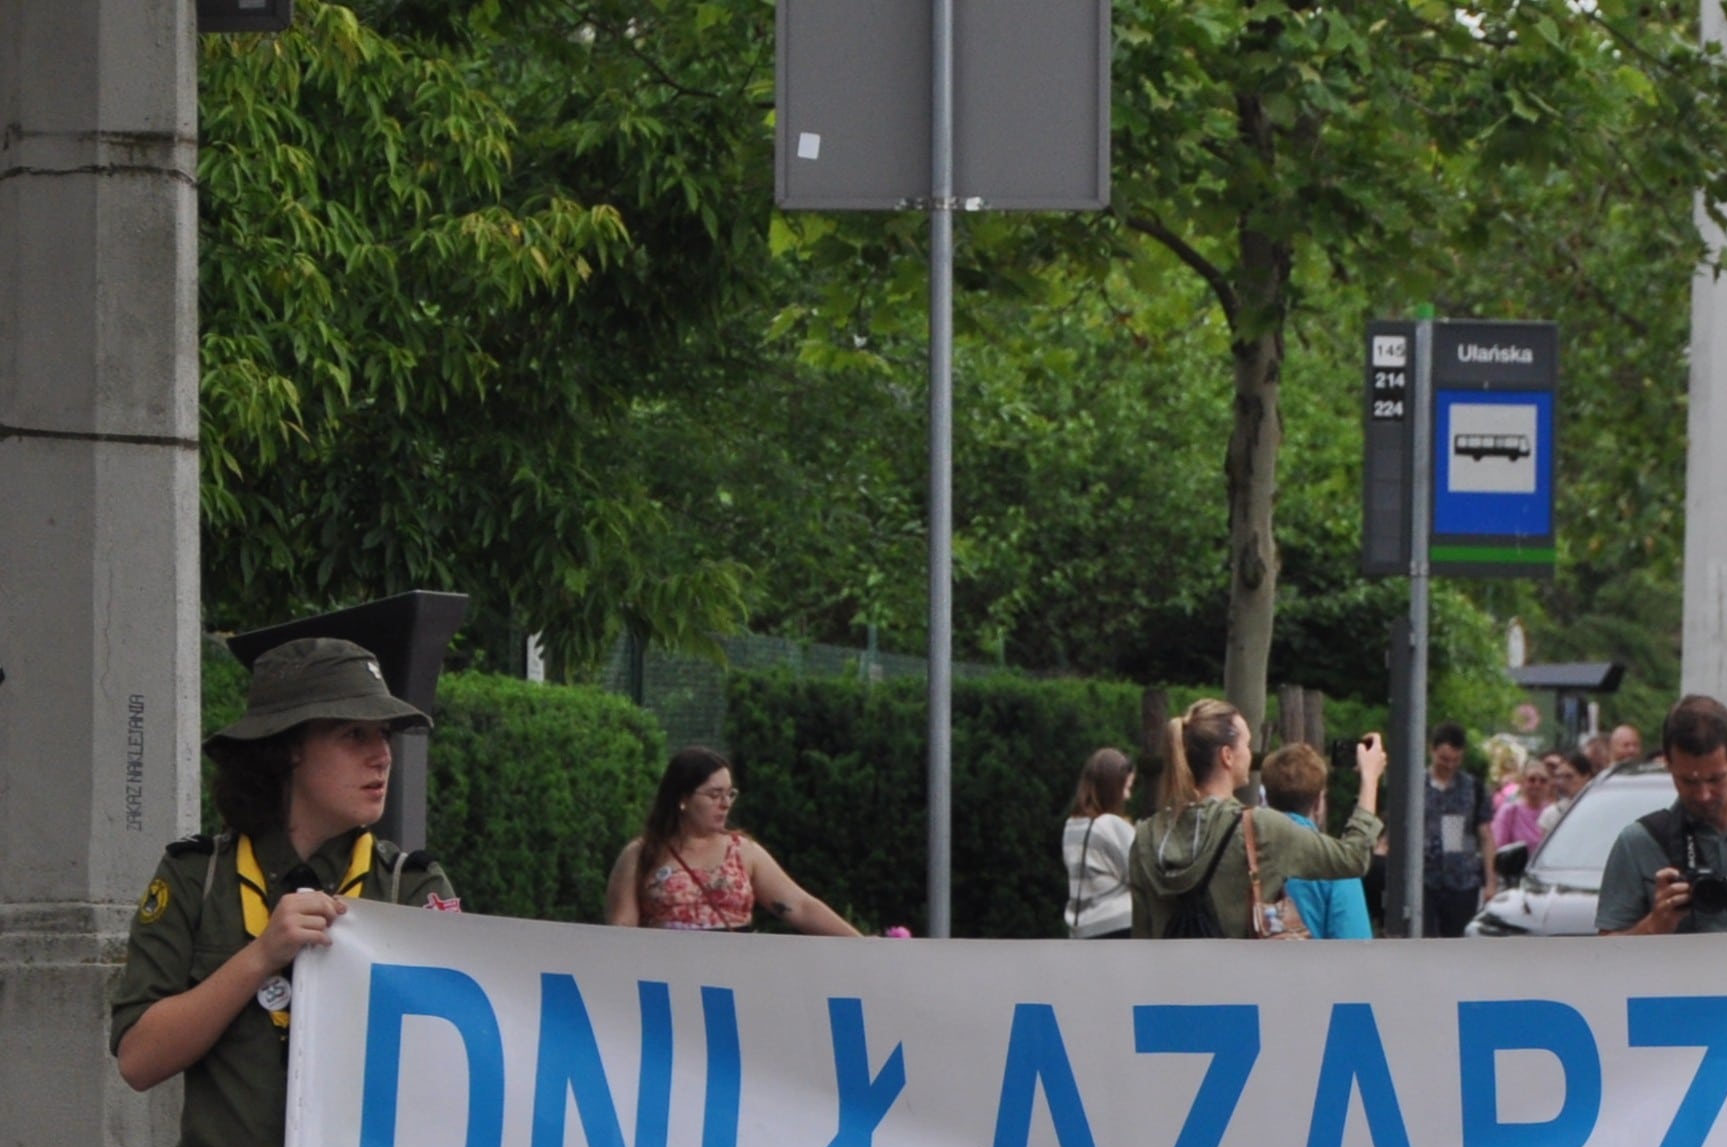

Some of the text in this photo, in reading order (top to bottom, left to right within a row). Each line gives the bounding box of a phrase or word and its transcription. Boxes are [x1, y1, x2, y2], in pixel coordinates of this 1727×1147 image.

[1457, 343, 1534, 364] Ulańska
[1375, 372, 1405, 389] 214
[1373, 400, 1404, 418] 224
[126, 694, 145, 832] ZAKAZ NAKLEJANIA
